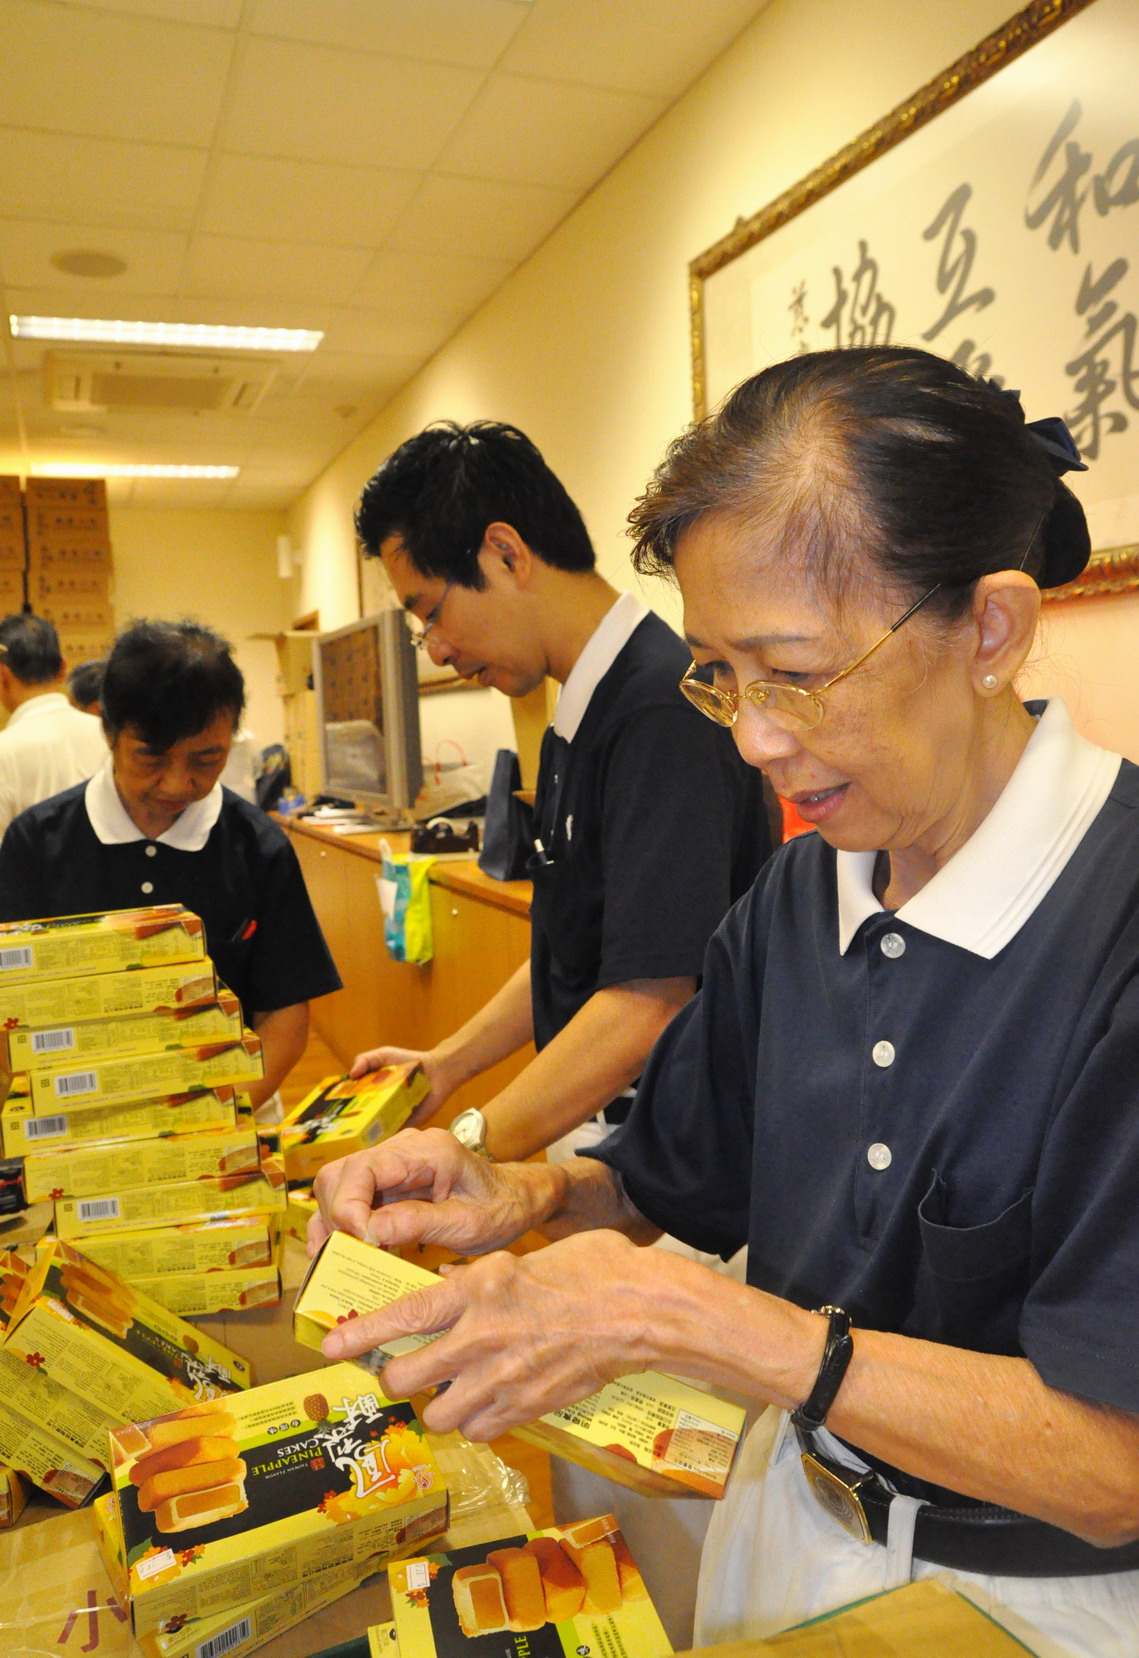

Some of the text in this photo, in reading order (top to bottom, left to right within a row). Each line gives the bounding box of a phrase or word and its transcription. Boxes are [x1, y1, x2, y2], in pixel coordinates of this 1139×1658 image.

[251, 1447, 323, 1477] PINEAPPLE
[277, 1438, 319, 1458] CAKES
[313, 1393, 396, 1498] 鳳梨酥
[56, 1589, 128, 1654] 小
